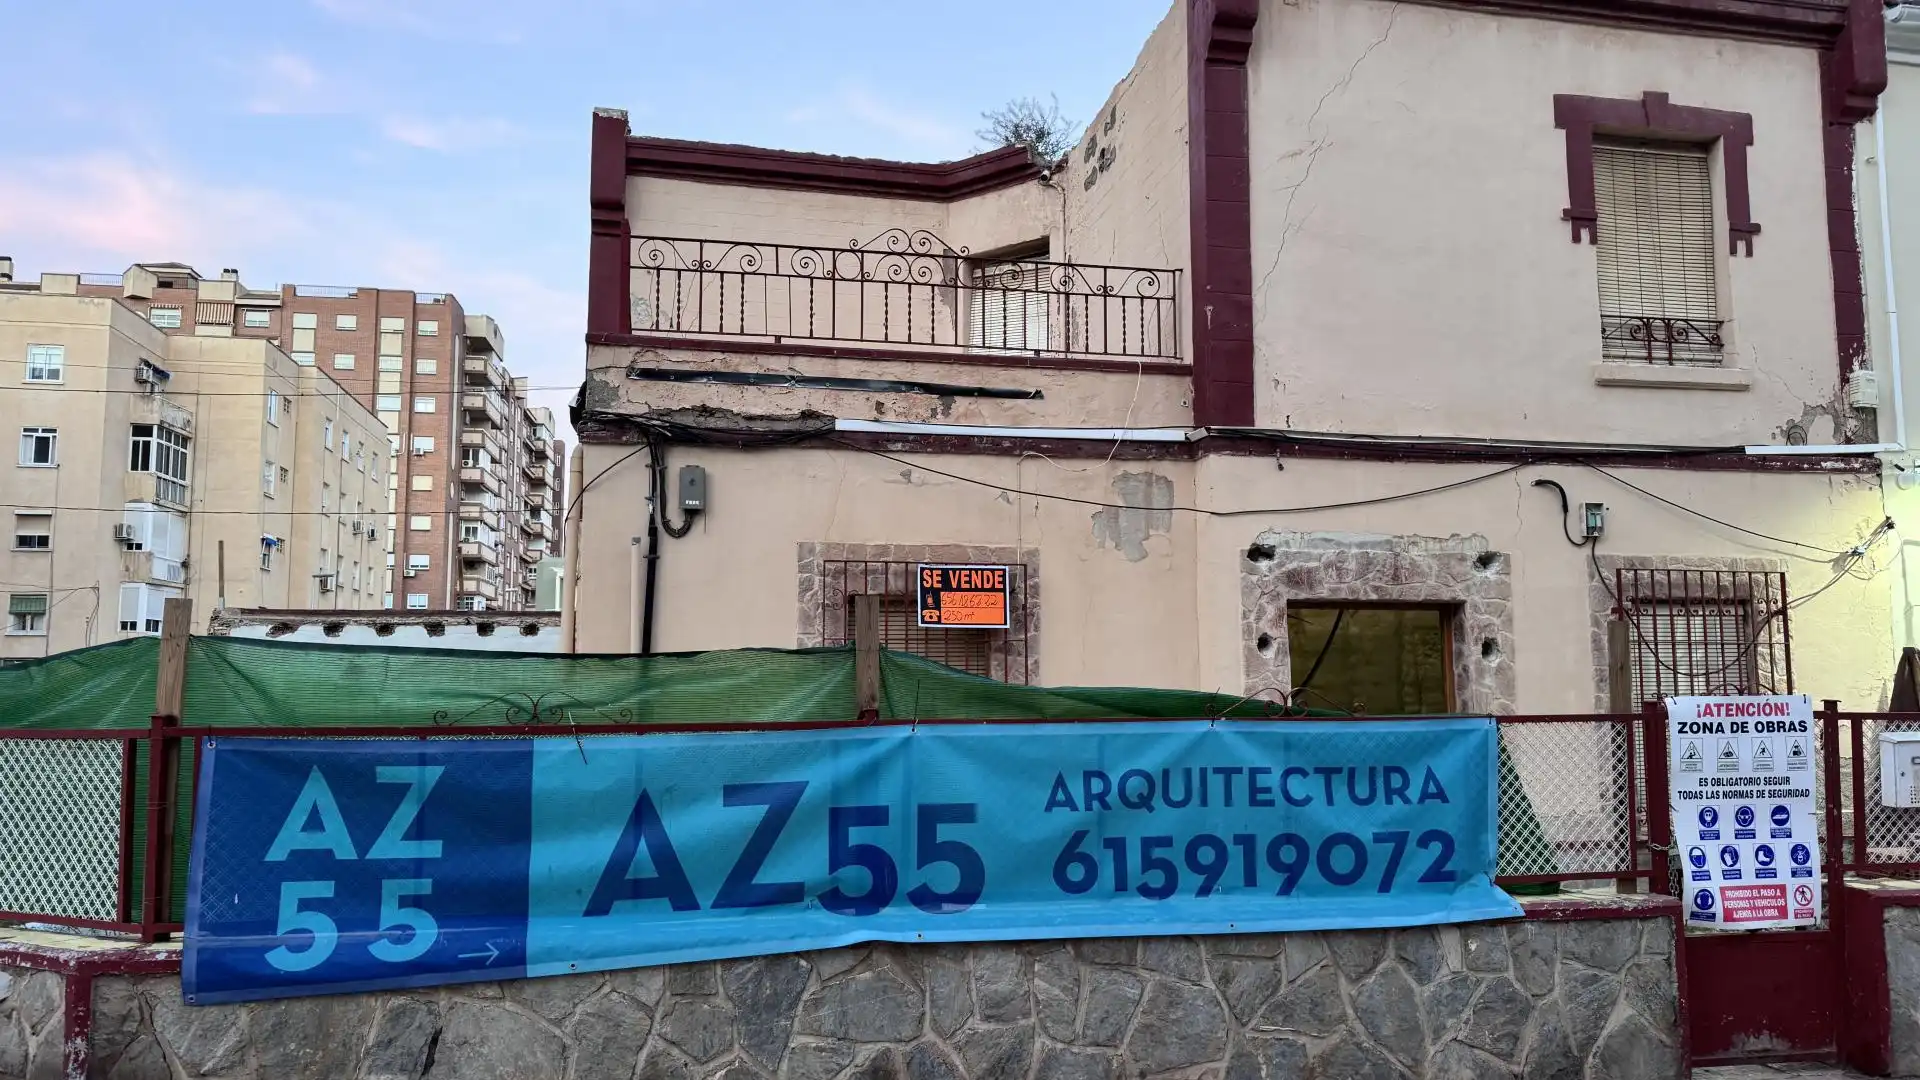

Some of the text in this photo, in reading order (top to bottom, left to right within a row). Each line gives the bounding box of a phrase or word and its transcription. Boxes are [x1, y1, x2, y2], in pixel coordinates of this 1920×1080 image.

[922, 569, 1004, 589] SE VENDE
[1696, 699, 1791, 718] ¡ATENCIÓN!
[1677, 720, 1808, 734] ZONA DE OBRAS
[1044, 764, 1450, 813] ARQUITECTURA
[1699, 776, 1791, 787] ES OBLIGATORIO SEGUIR
[1677, 788, 1810, 800] TODAS LAS NORMAS DE SEGURIDAD
[264, 764, 446, 861] AZ
[1052, 830, 1457, 898] 615919072
[1725, 889, 1752, 898] PROHIBIDO
[1752, 889, 1760, 897] EL
[1760, 889, 1775, 897] PASO
[1723, 900, 1750, 908] PERSONAS
[1764, 909, 1779, 917] OBRA
